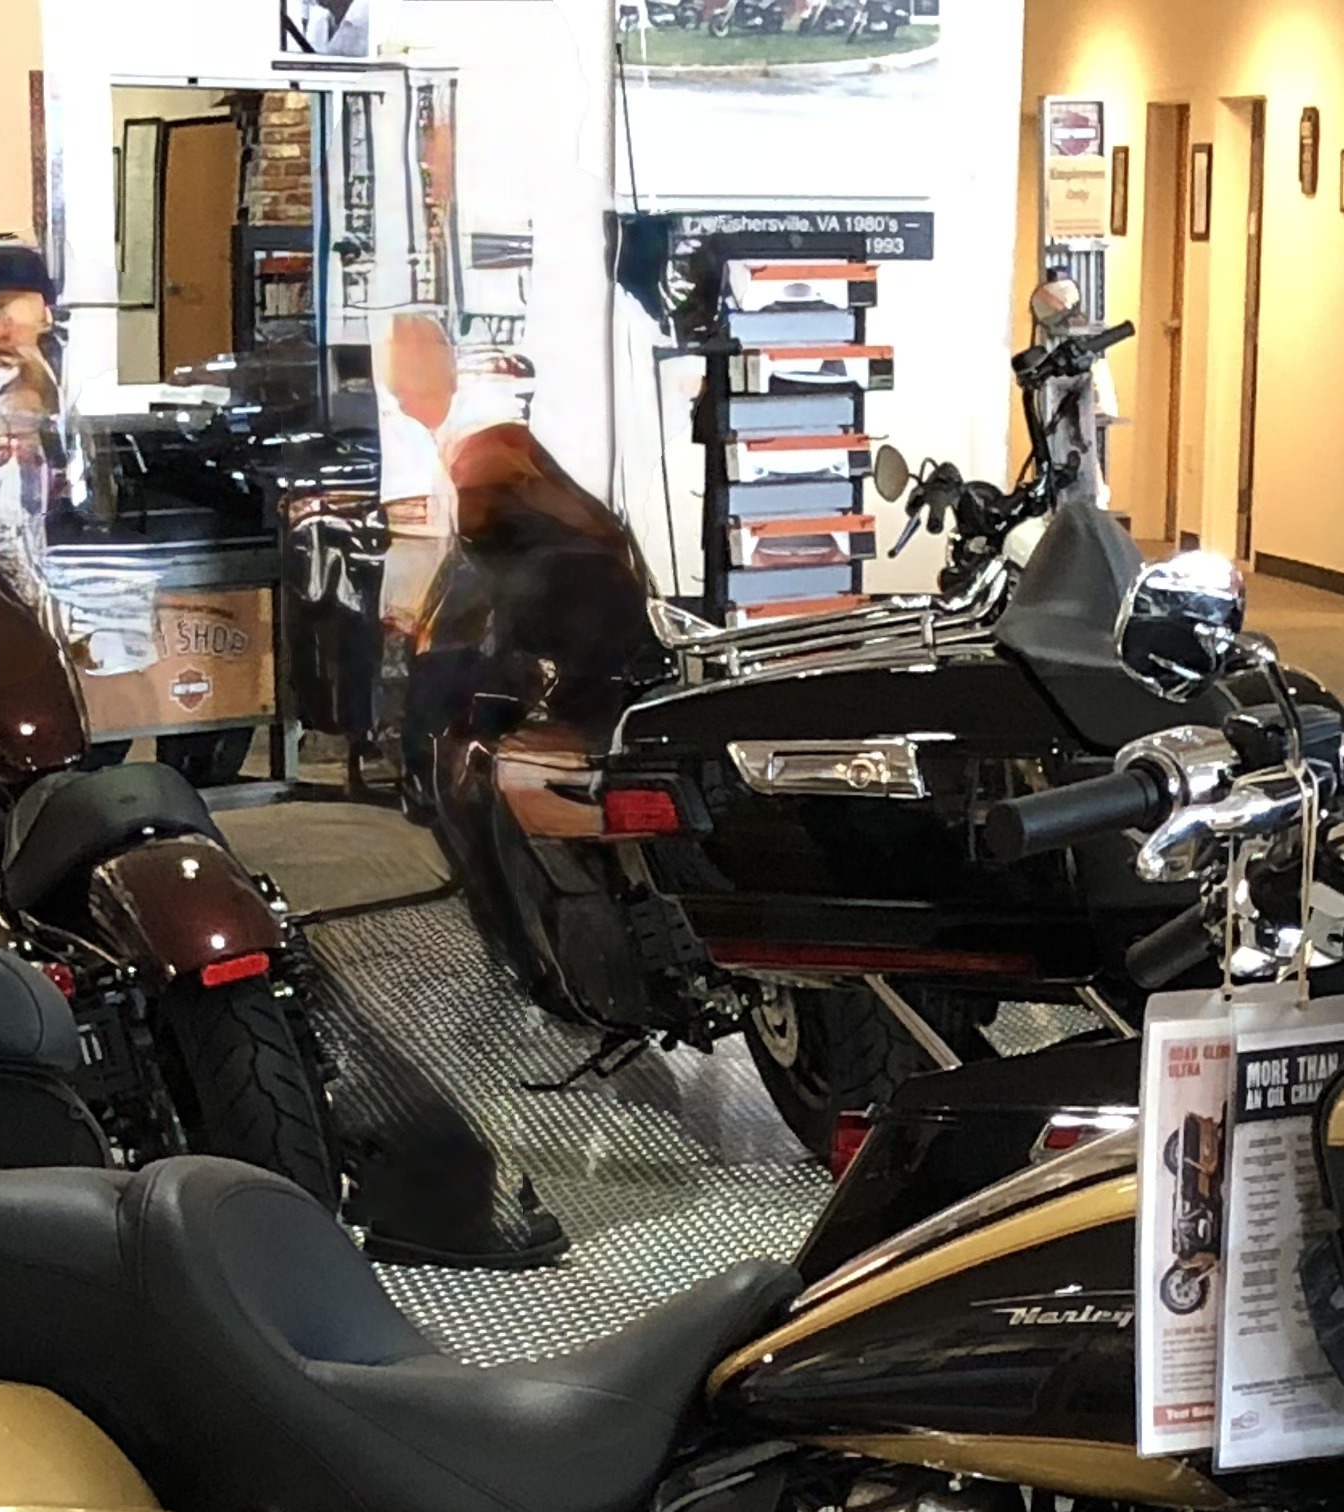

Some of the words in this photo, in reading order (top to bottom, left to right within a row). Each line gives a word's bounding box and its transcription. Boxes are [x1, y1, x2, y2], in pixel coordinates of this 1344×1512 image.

[816, 216, 841, 232] VA
[845, 215, 899, 233] 1980's
[864, 238, 905, 254] 1993
[1246, 1058, 1290, 1089] MORE
[1297, 1051, 1339, 1082] THAN
[1245, 1088, 1263, 1112] AN
[1267, 1085, 1286, 1109] OIL
[991, 1304, 1135, 1328] Harley
